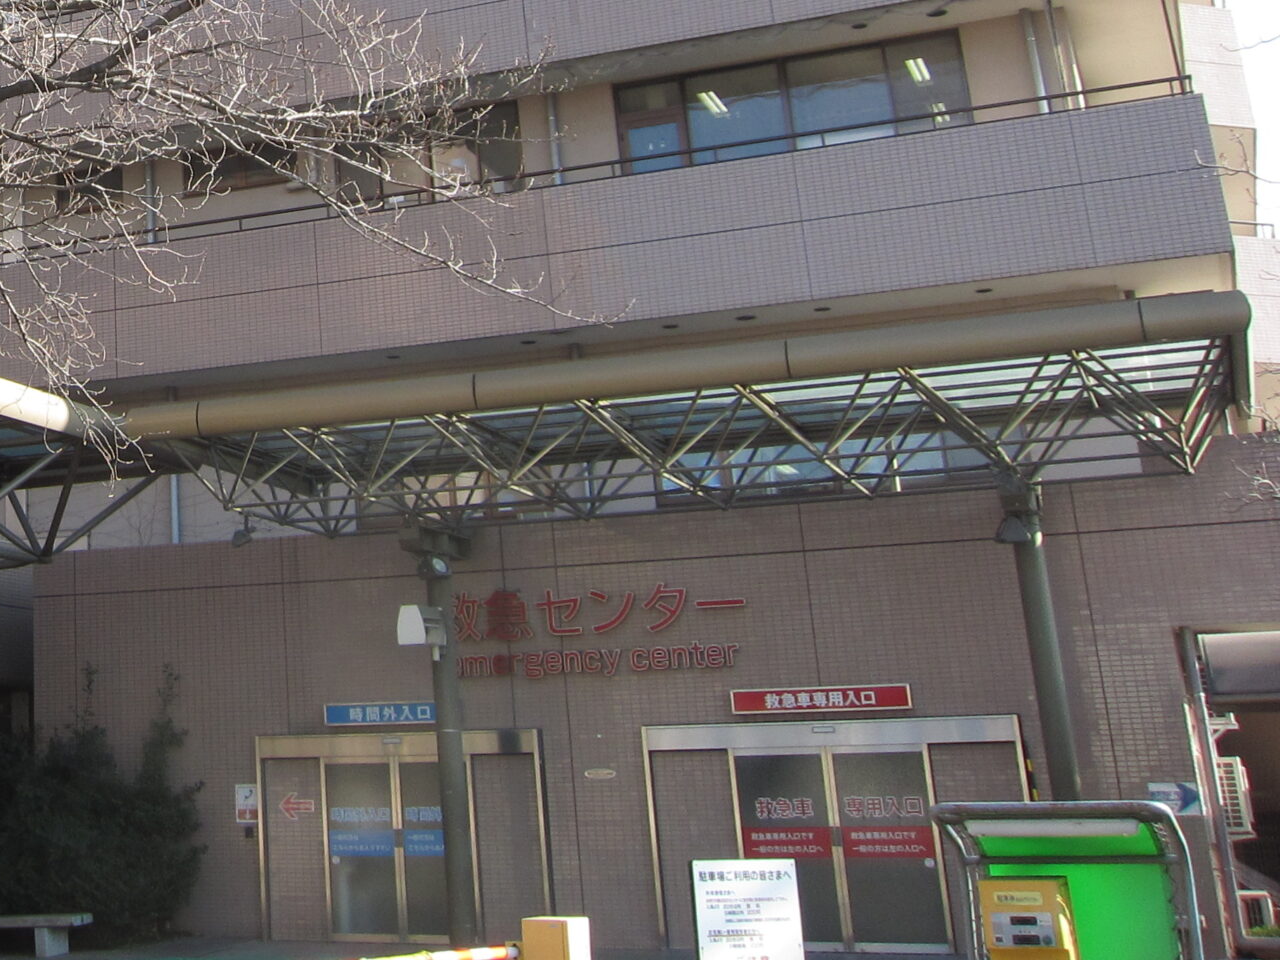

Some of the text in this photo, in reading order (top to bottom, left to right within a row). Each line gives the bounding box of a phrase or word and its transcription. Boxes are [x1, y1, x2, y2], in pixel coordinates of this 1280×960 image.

[457, 640, 740, 679] mergency center
[764, 690, 877, 709] 救急車専用入口
[349, 705, 431, 722] 時間外入口
[755, 797, 814, 819] 救急車
[844, 795, 925, 817] 専用入口
